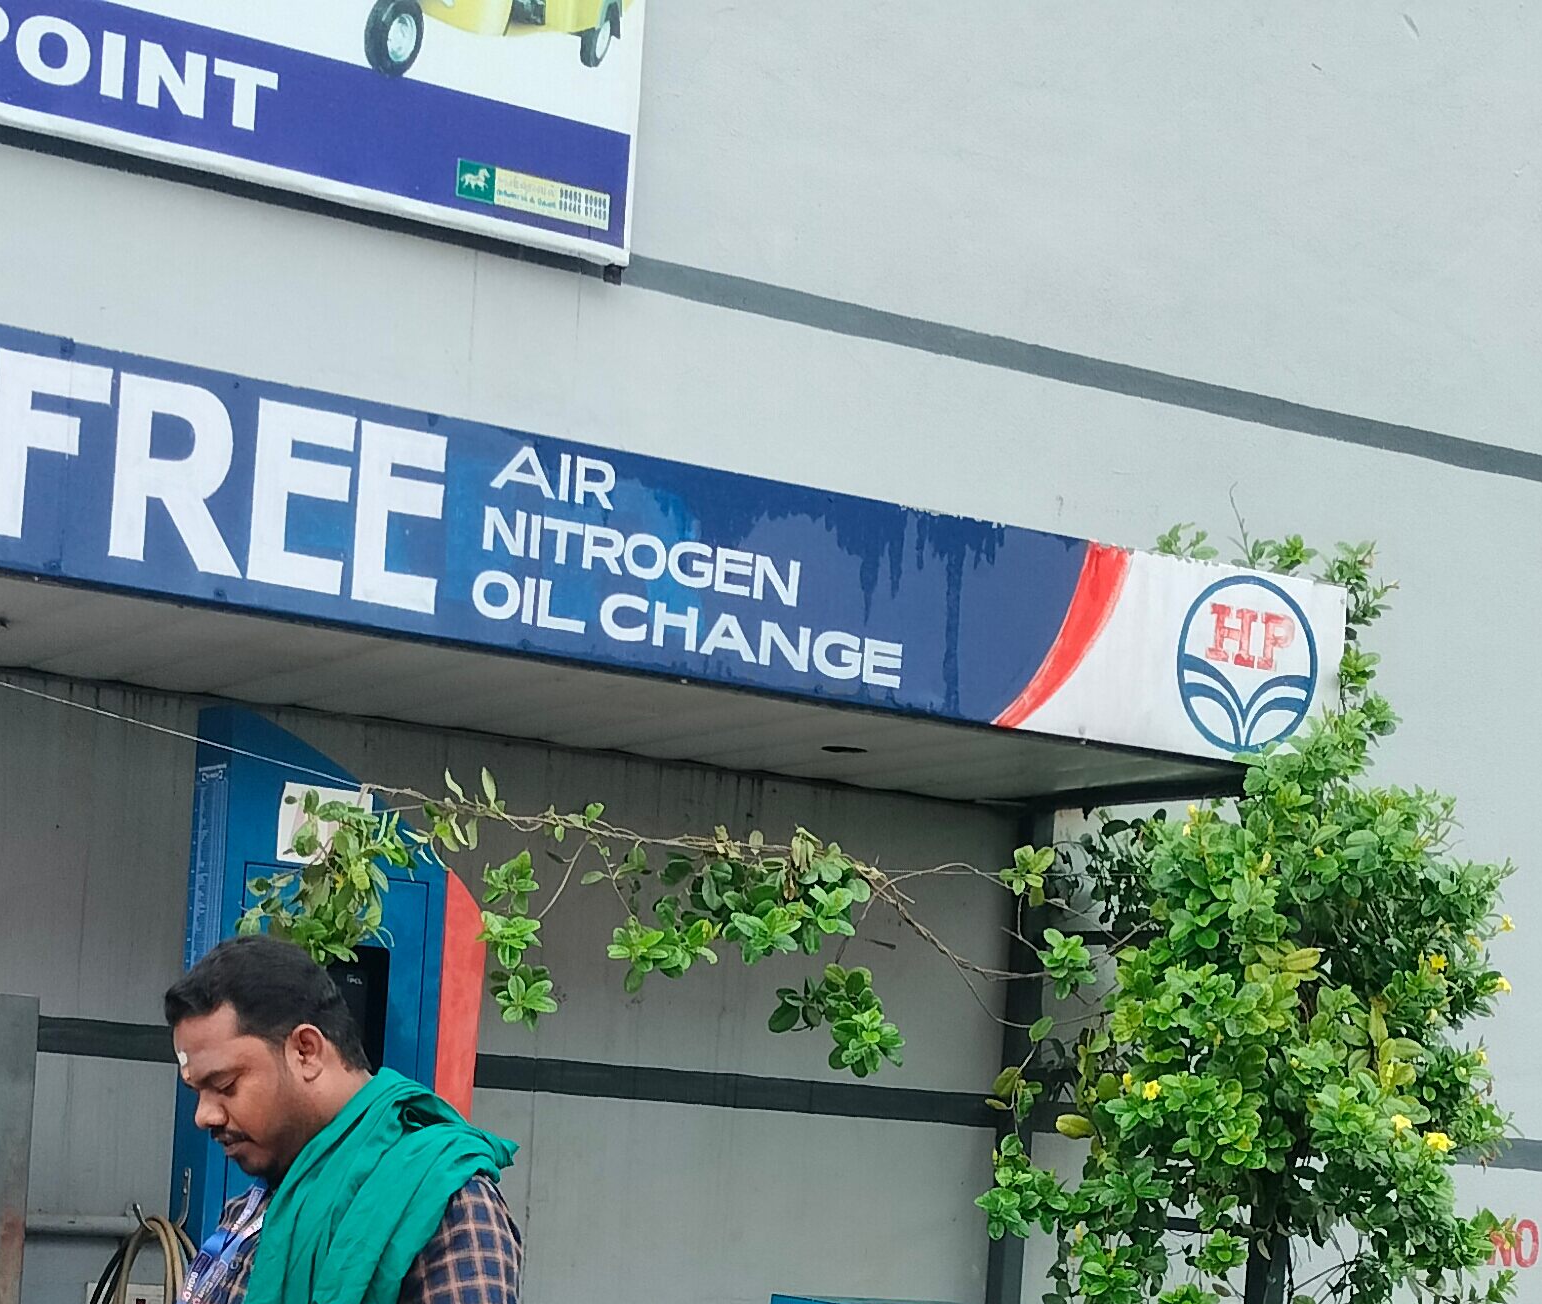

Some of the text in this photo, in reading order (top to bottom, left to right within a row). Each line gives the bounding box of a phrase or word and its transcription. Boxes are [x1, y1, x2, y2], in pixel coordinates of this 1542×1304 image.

[489, 445, 616, 511] AIR
[482, 504, 801, 607] NITROGEN
[471, 569, 903, 689] OIL CHANGE
[1204, 601, 1296, 671] HP
